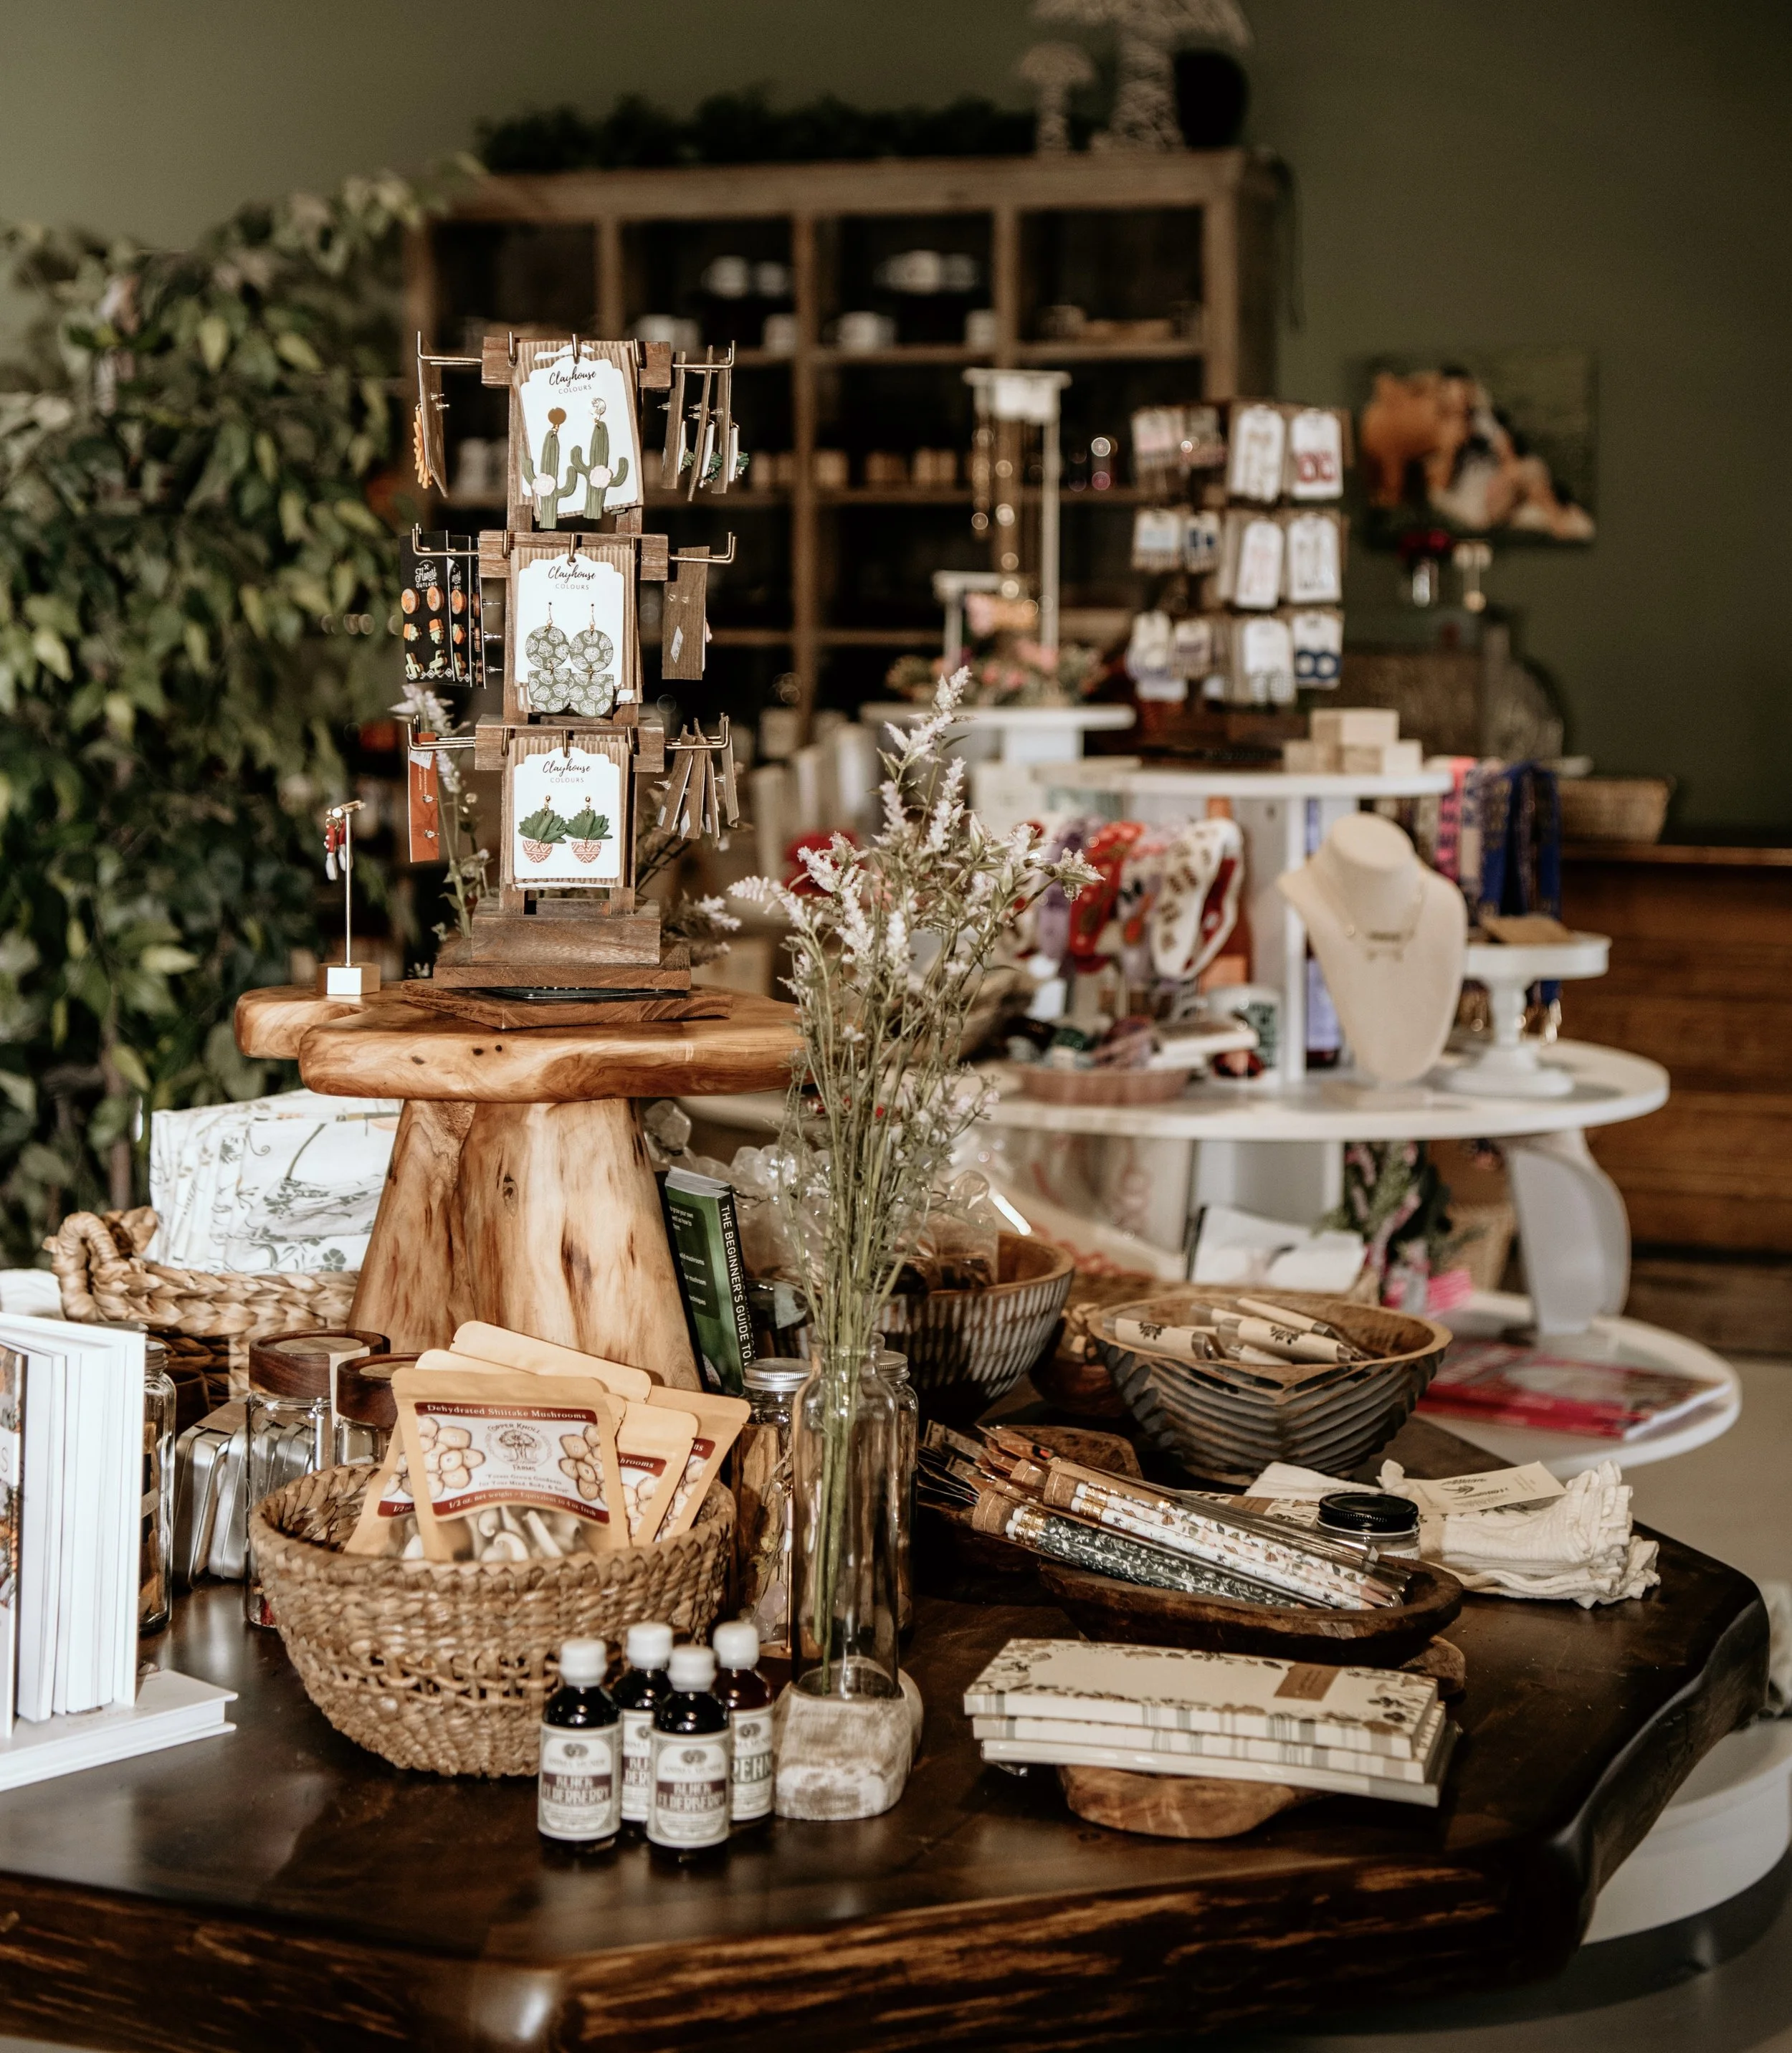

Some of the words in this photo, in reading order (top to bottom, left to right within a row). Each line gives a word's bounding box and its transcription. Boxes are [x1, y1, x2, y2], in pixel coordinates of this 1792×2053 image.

[549, 366, 596, 387] Clayhouse
[558, 384, 592, 394] COLOURS
[548, 564, 596, 583] Clayhouse
[543, 758, 591, 777] Clayhouse
[721, 1205, 732, 1229] THE
[725, 1232, 743, 1302] BEGINNER'S
[736, 1305, 749, 1341] GUIDE
[742, 1343, 752, 1358] TO
[427, 1404, 485, 1415] Dehydrated
[487, 1408, 528, 1417] Shiitake
[531, 1409, 586, 1419] Mushrooms
[449, 1500, 462, 1509] 1/2
[556, 1775, 594, 1790] BLACK
[674, 1782, 712, 1797] BLACK
[541, 1783, 609, 1806] ELDERBERRY
[657, 1791, 725, 1813] ELDERBERRY
